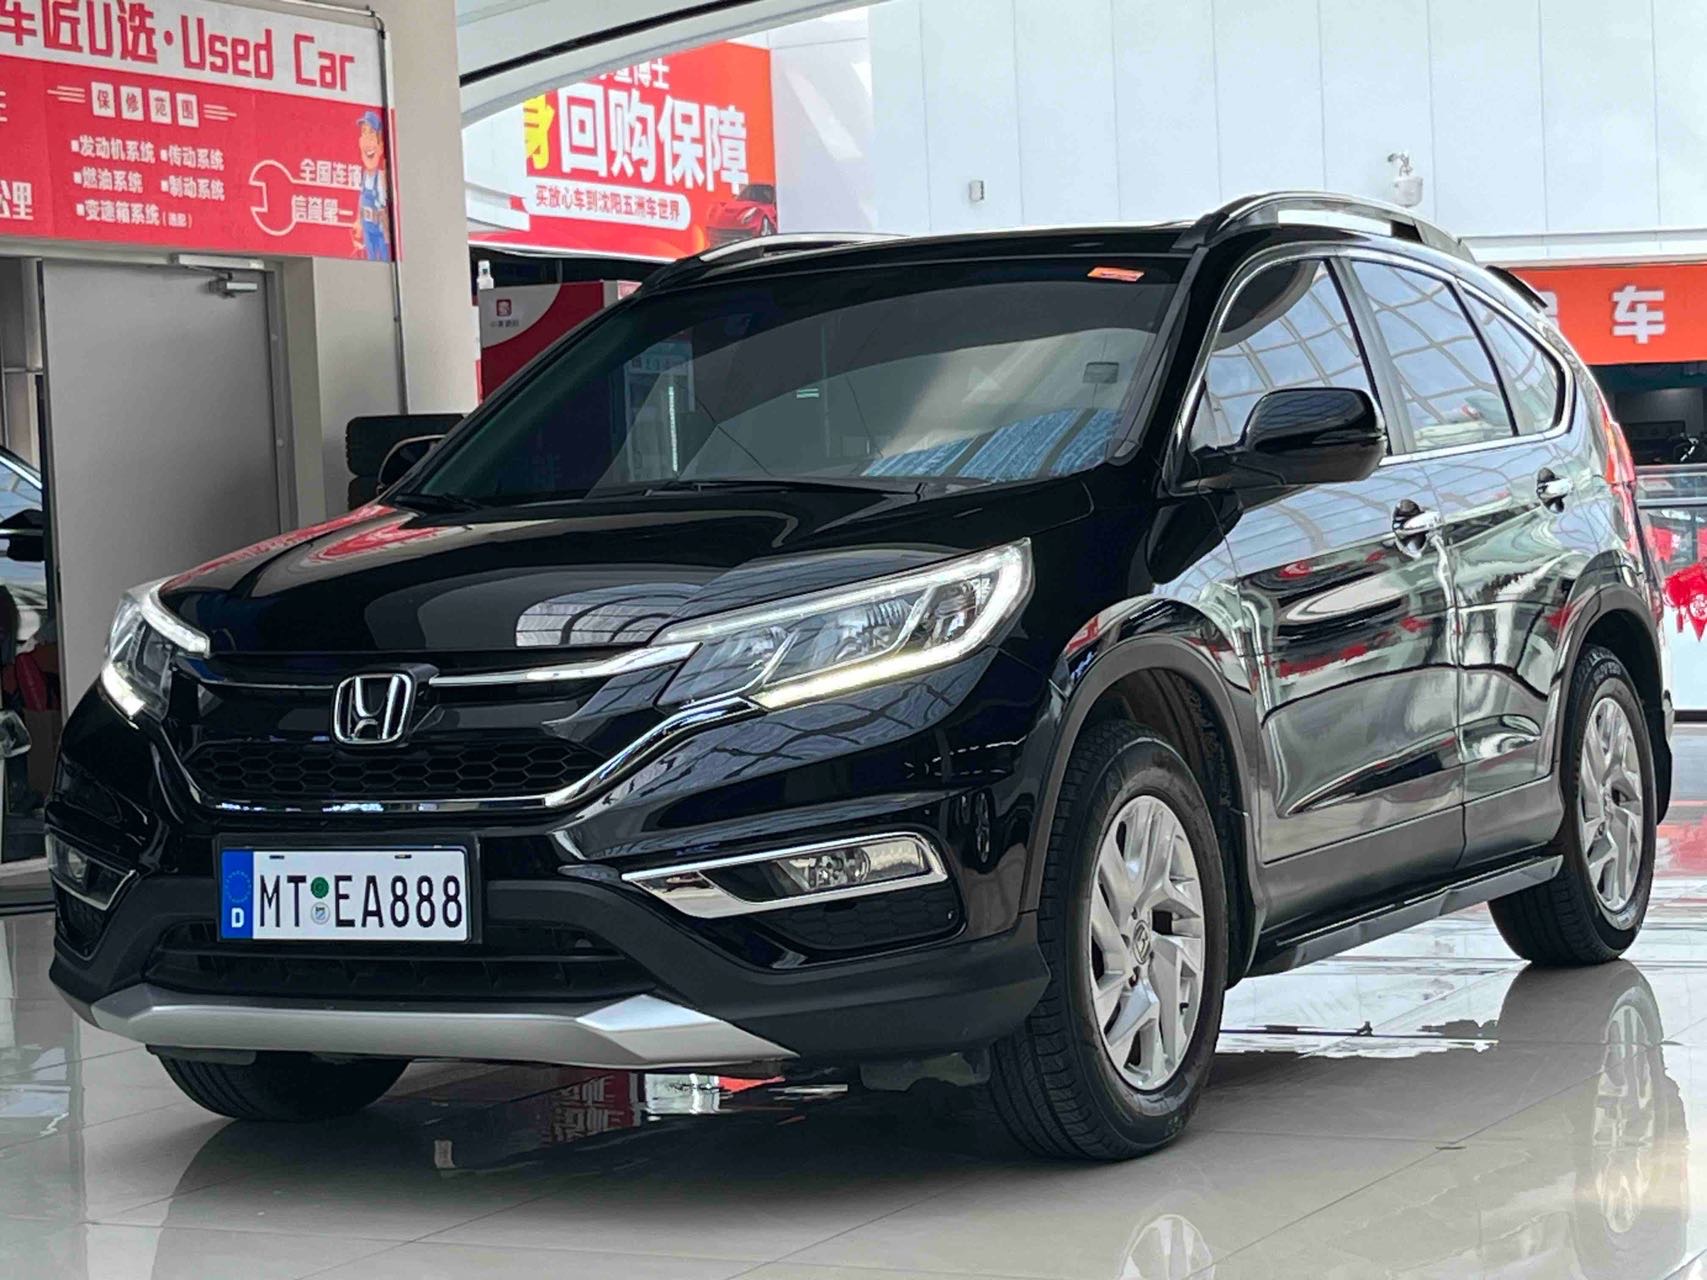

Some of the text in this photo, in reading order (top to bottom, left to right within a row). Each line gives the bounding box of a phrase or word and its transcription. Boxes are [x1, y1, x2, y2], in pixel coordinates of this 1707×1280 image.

[180, 14, 274, 81] Used
[293, 32, 356, 92] Car
[231, 907, 245, 928] D
[259, 874, 463, 929] MT EA888
